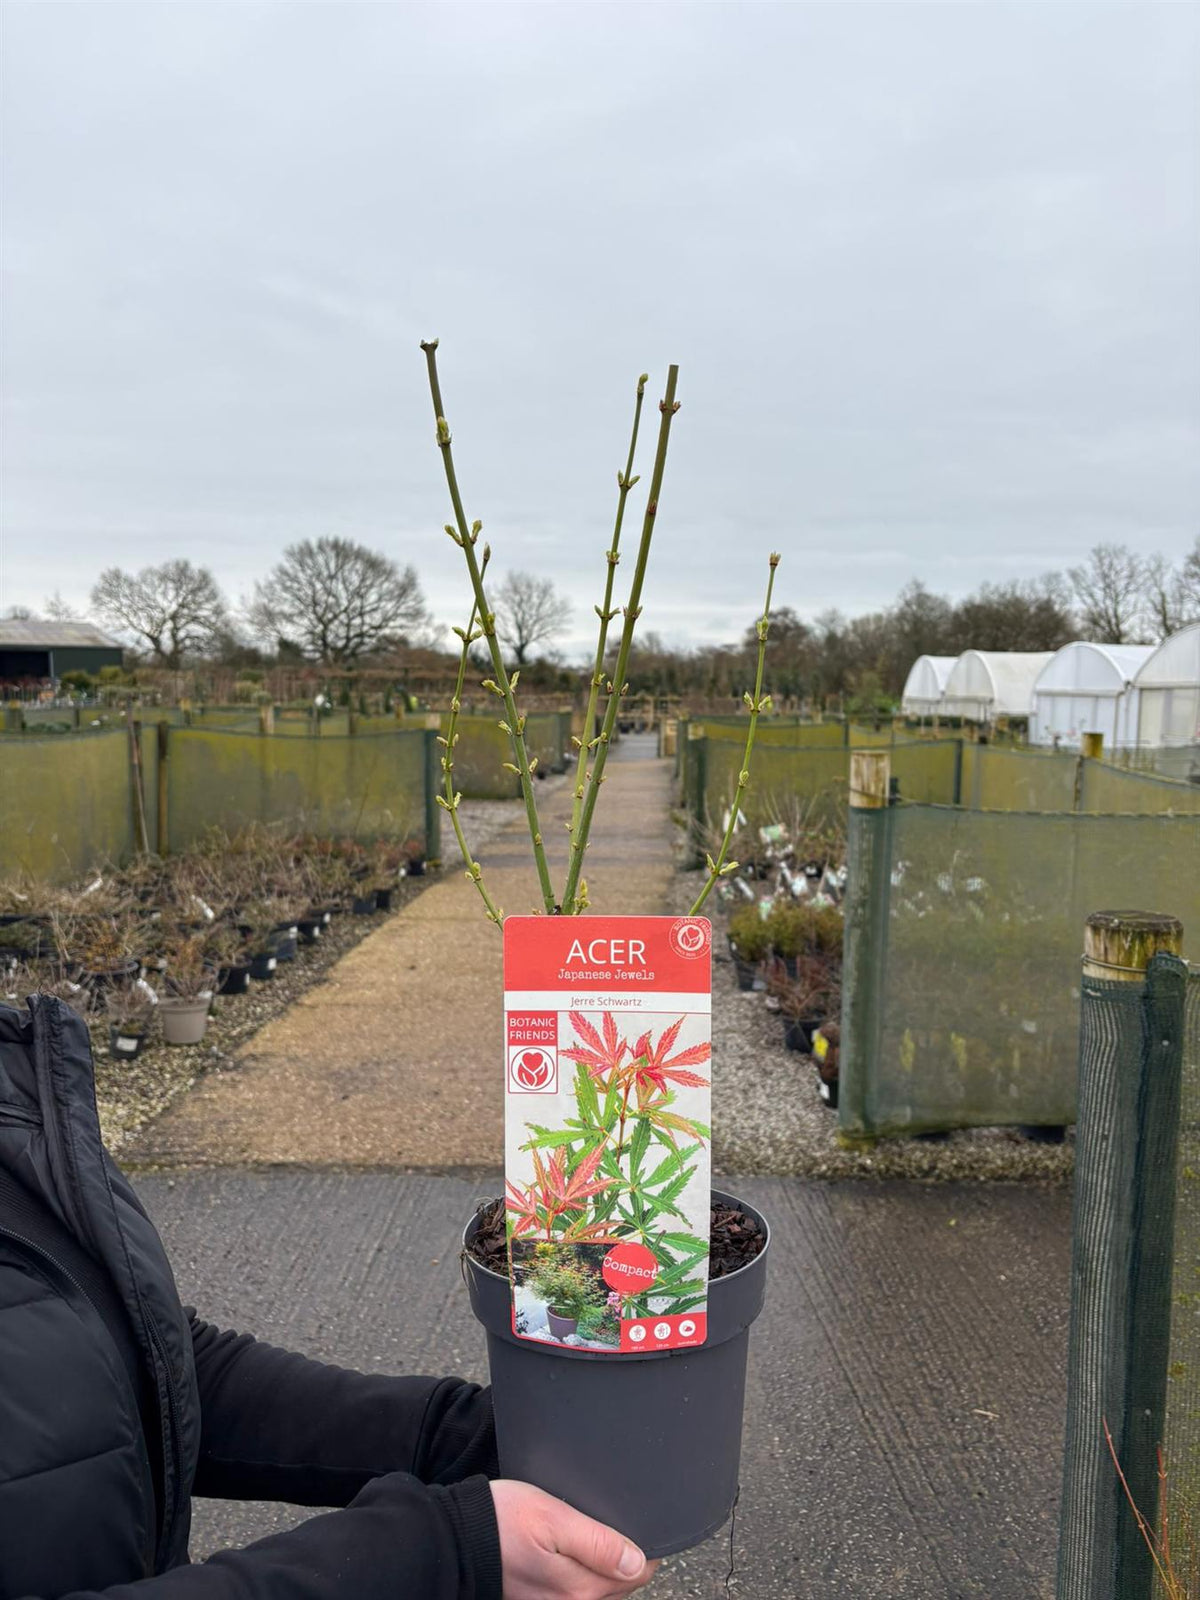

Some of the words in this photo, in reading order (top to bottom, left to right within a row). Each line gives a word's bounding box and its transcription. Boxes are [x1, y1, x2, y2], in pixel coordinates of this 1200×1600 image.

[566, 939, 646, 964] ACER
[558, 969, 611, 981] Japanese
[614, 969, 655, 980] Jewels
[570, 997, 595, 1007] Jerre
[597, 997, 642, 1007] Schwartz
[509, 1017, 555, 1027] BOTANIC
[509, 1031, 555, 1040] FRIENDS
[603, 1256, 660, 1279] Compact
